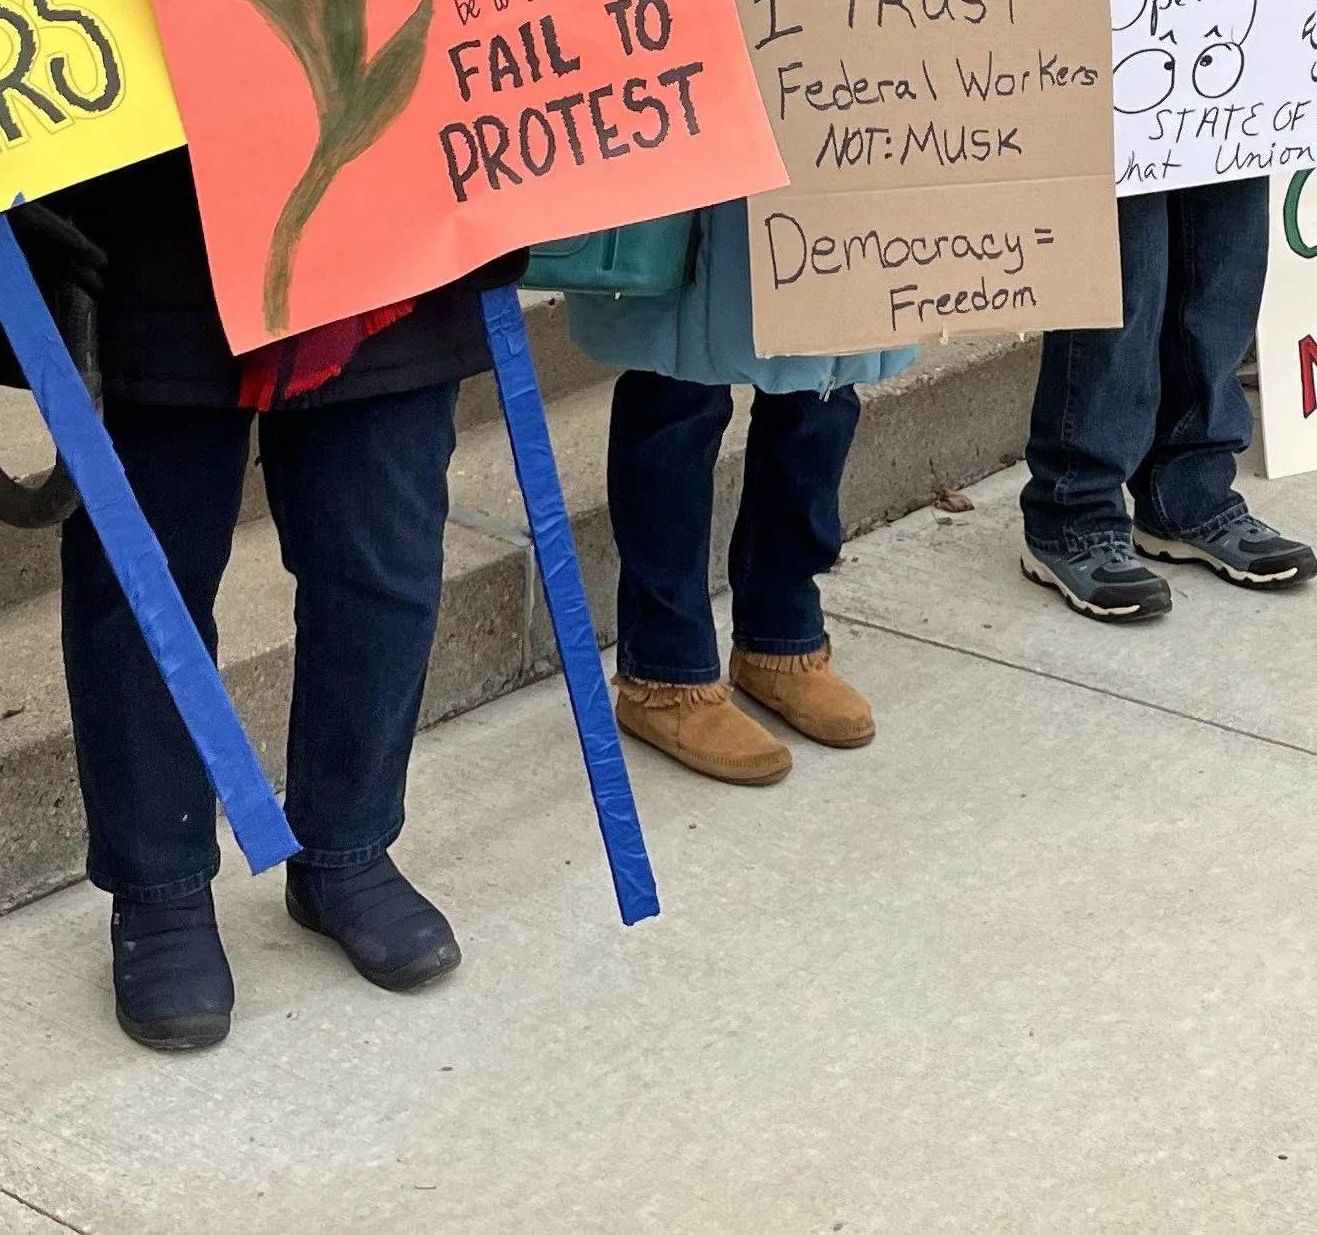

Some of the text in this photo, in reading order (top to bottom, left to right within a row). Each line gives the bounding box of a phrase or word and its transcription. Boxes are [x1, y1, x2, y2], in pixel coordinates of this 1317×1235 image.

[448, 14, 581, 103] FAIL
[777, 59, 938, 121] Federal
[438, 62, 704, 203] PROTEST
[1149, 100, 1312, 143] STATE OF
[890, 275, 1037, 331] Freedom
